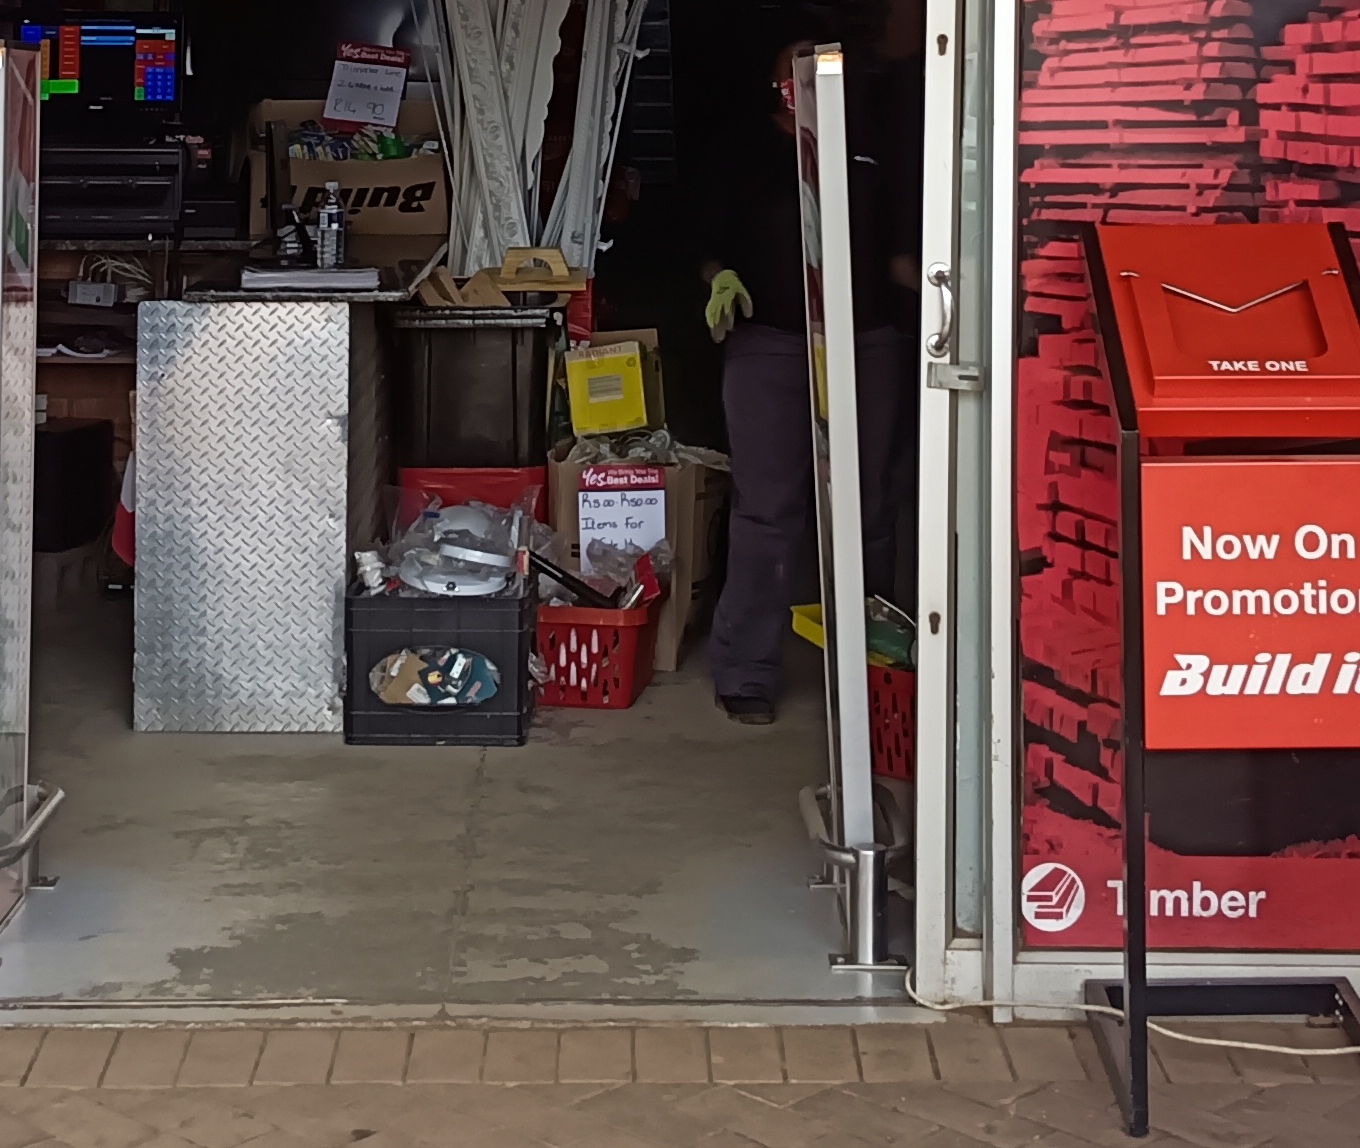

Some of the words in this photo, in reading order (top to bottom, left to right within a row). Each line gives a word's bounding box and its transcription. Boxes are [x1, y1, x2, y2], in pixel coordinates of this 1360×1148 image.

[1207, 360, 1260, 372] TAKE
[1265, 360, 1309, 372] ONE
[1181, 525, 1280, 561] Now
[1294, 523, 1356, 560] On
[1159, 652, 1332, 697] Build
[1106, 880, 1267, 920] Tmber
